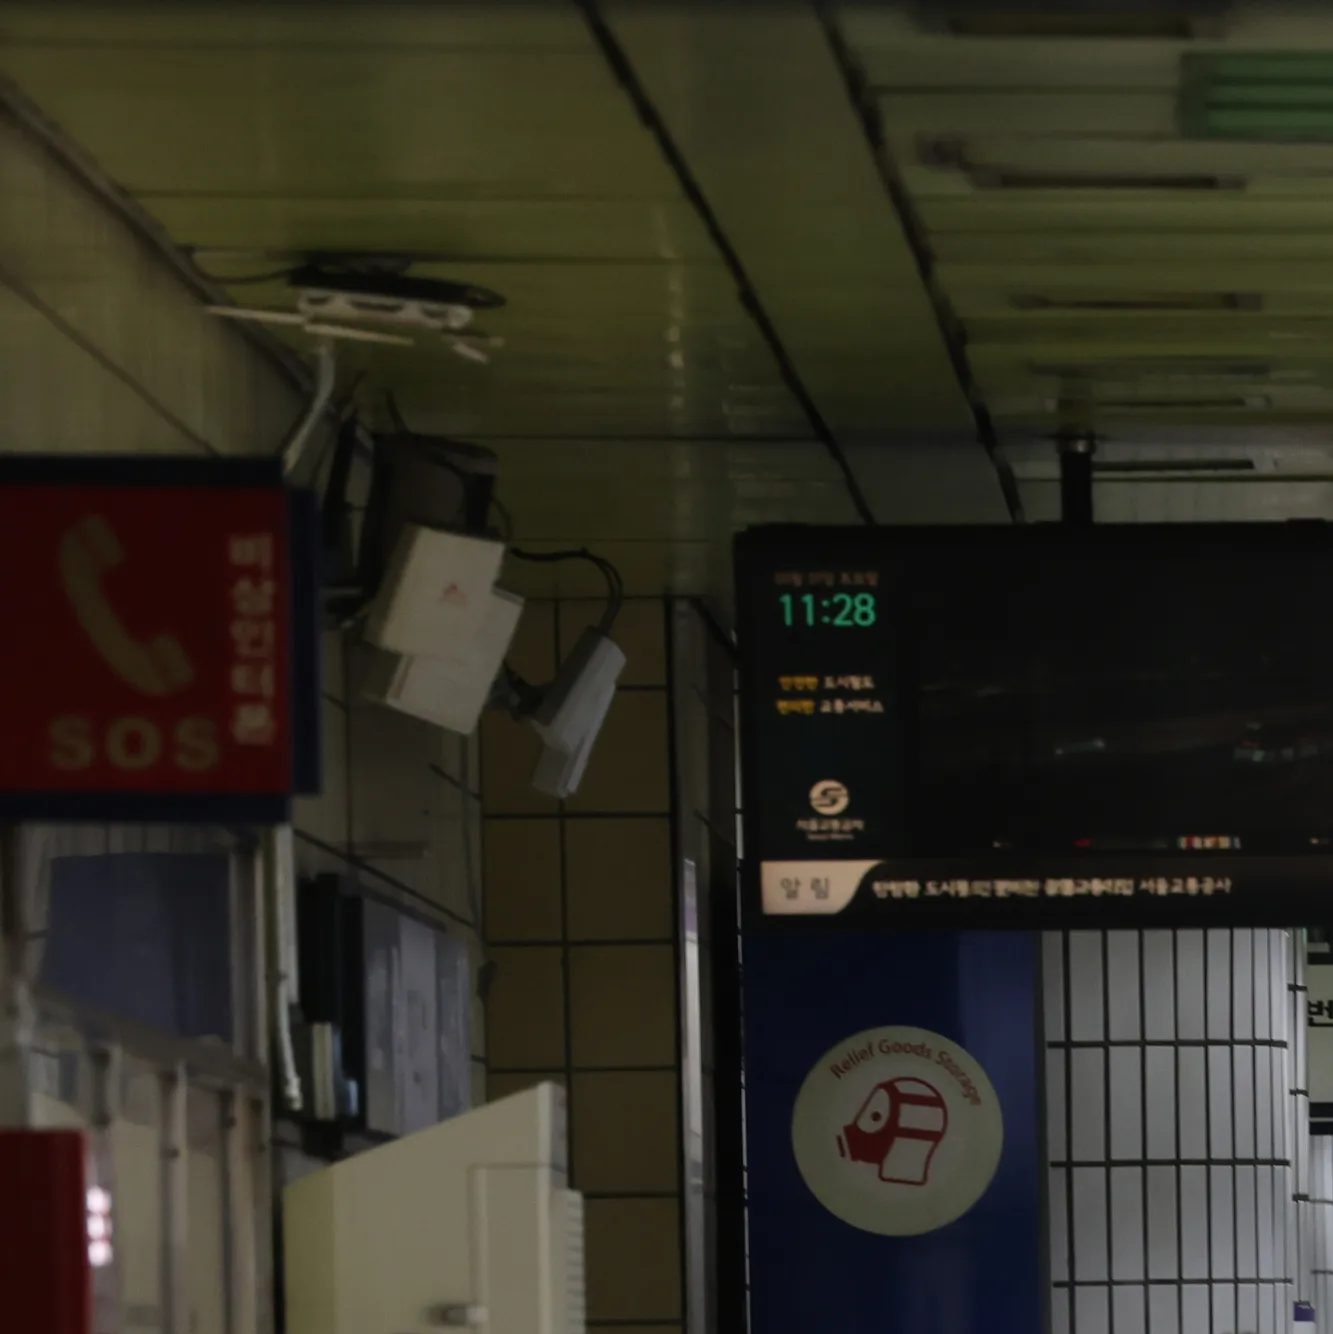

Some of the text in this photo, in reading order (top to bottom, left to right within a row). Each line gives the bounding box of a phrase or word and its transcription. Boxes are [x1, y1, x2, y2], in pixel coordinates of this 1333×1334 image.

[779, 593, 876, 627] 11:28
[48, 717, 220, 771] SOS
[829, 1038, 982, 1106] Relief Goods Storage
